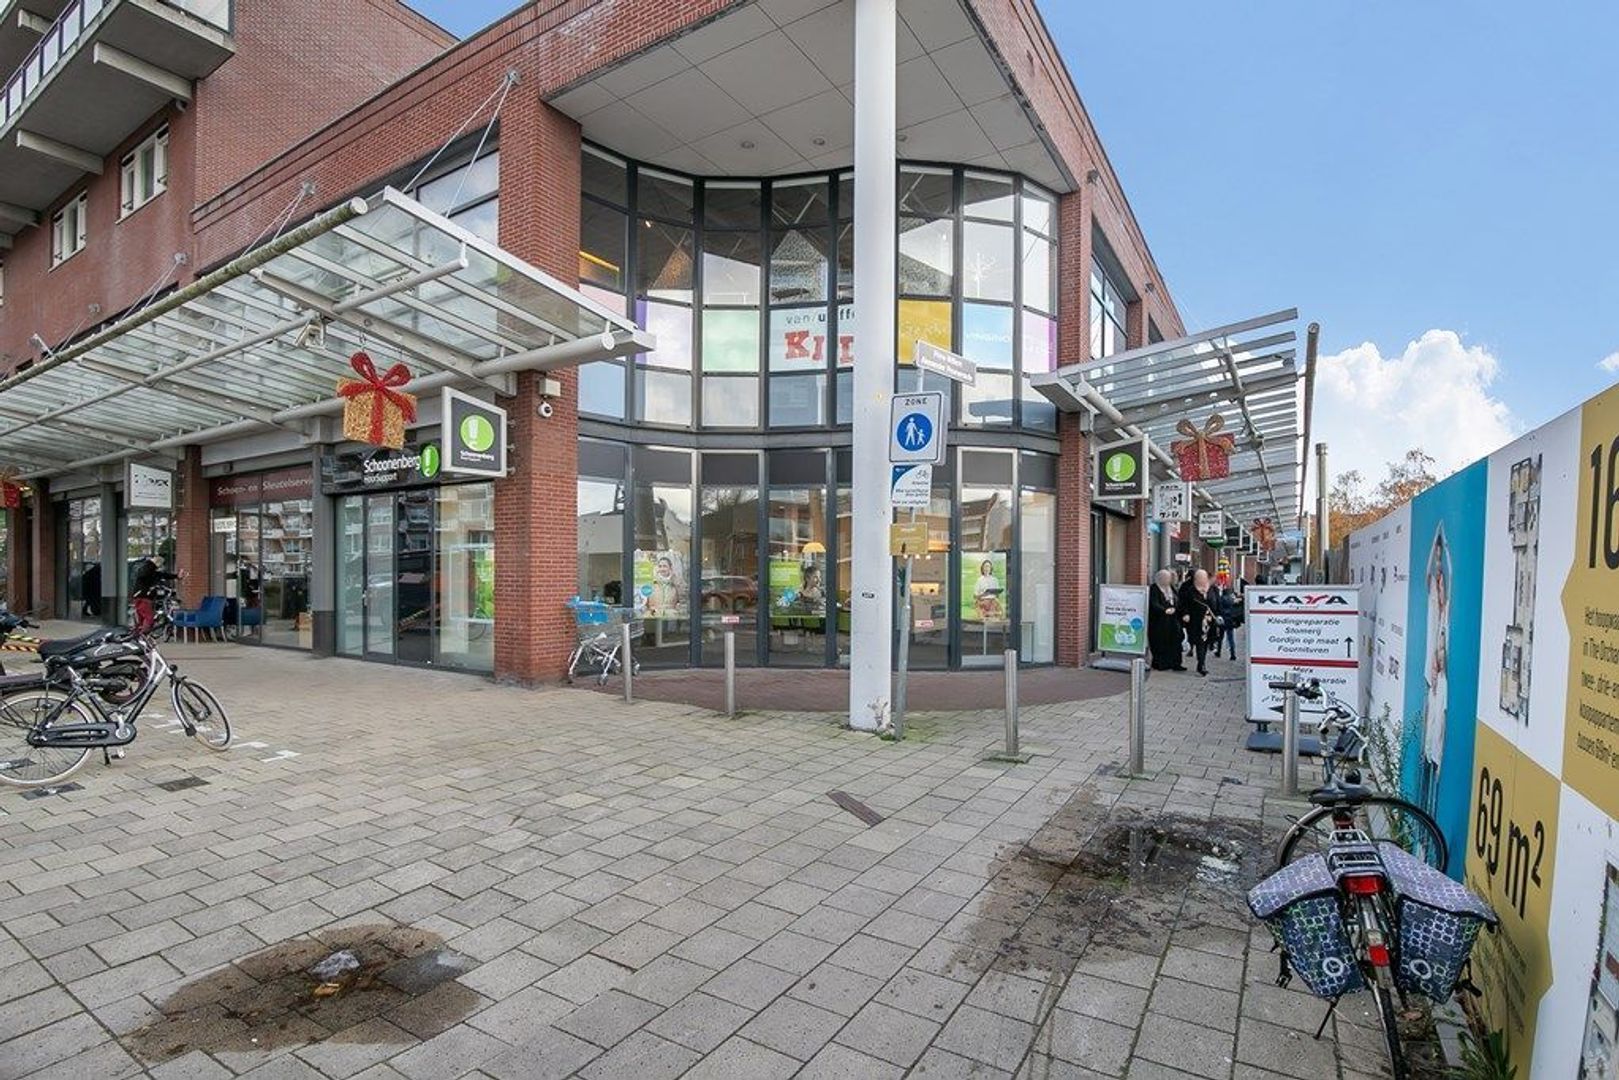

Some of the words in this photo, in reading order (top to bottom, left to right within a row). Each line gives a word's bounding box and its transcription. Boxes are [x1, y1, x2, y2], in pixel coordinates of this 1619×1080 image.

[905, 398, 928, 406] ZONE
[363, 454, 421, 474] Schoonenberg
[1258, 594, 1349, 605] KAYA
[1266, 616, 1341, 626] Kledingreparatie
[1284, 626, 1322, 636] Stomerij
[1268, 636, 1301, 645] Gordijn
[1278, 645, 1330, 654] Fournituren
[1476, 766, 1503, 876] 69
